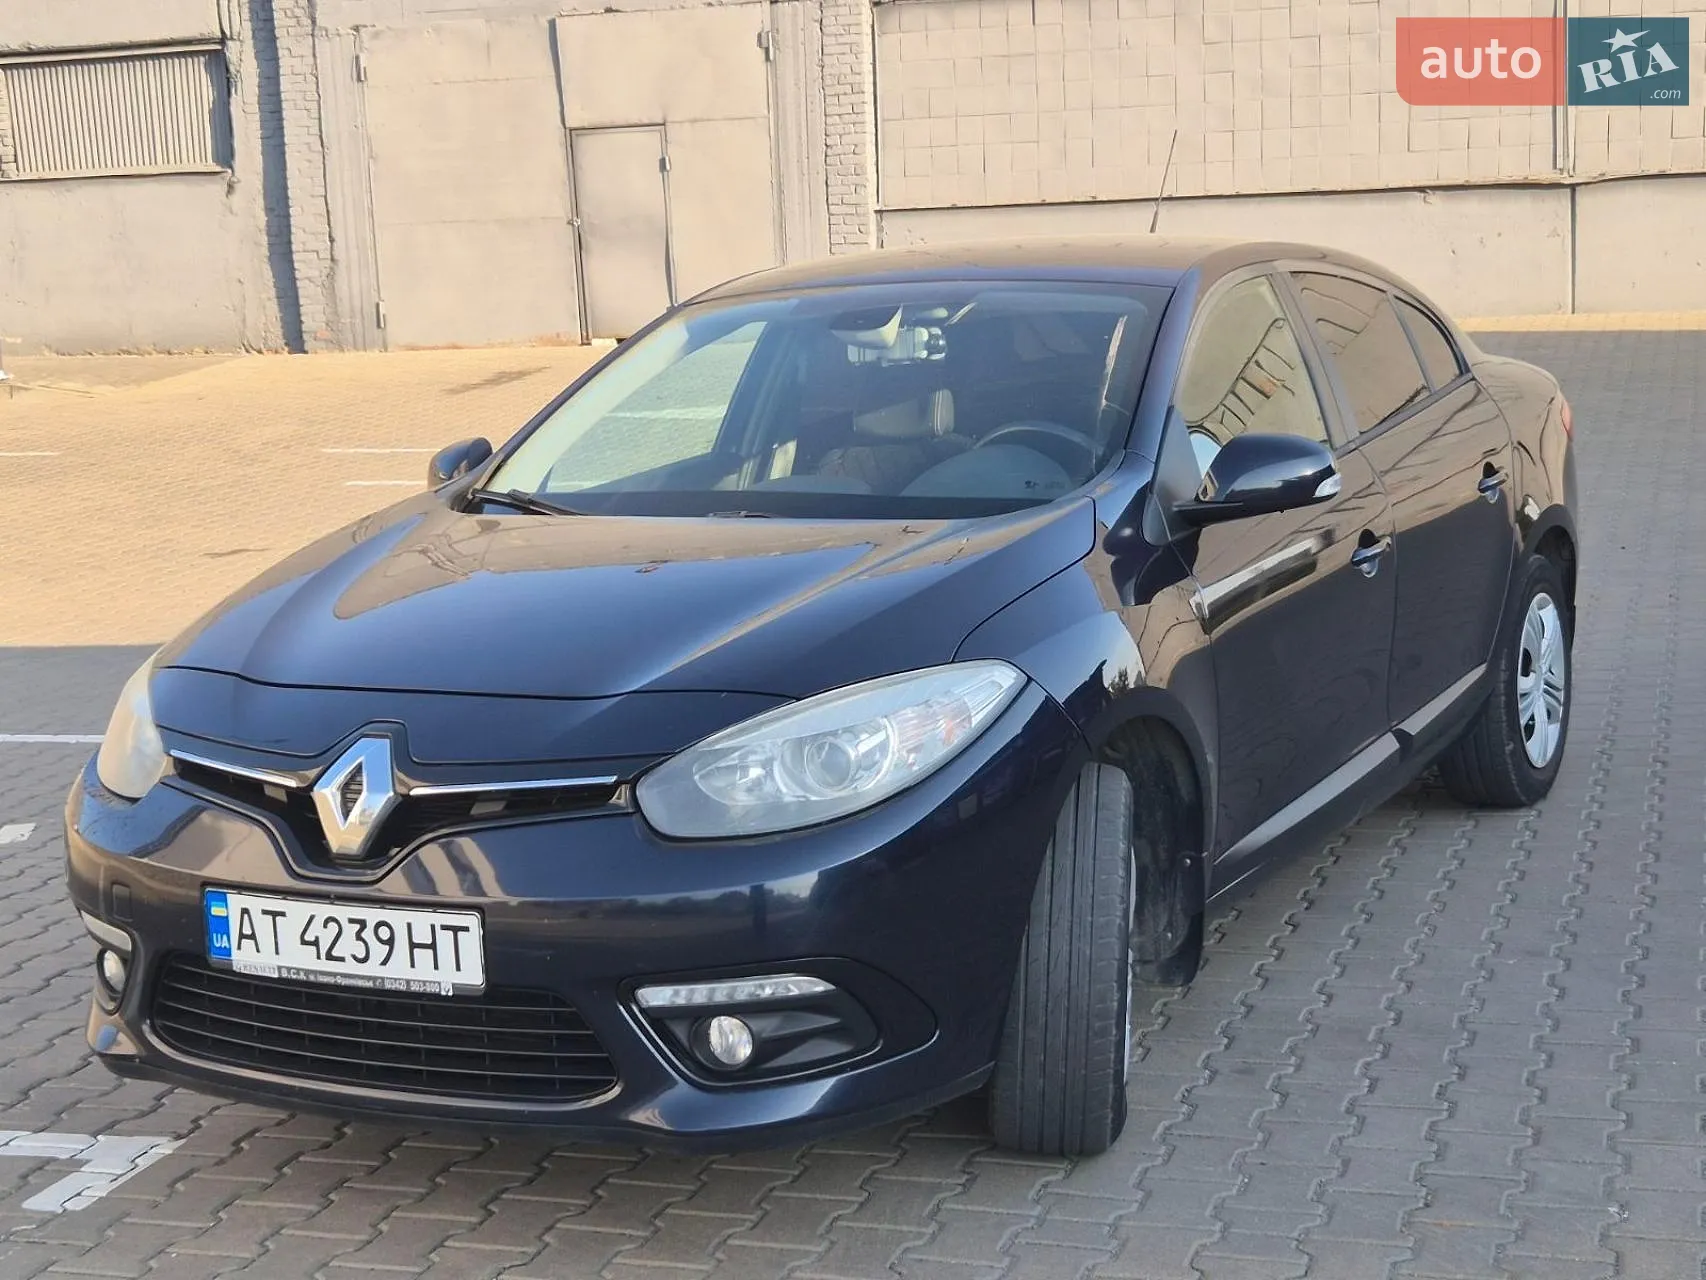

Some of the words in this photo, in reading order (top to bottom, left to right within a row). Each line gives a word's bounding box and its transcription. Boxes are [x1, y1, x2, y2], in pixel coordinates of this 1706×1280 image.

[213, 932, 230, 949] UA
[236, 907, 287, 955] AT
[300, 914, 396, 967] 4239
[406, 921, 471, 972] HT
